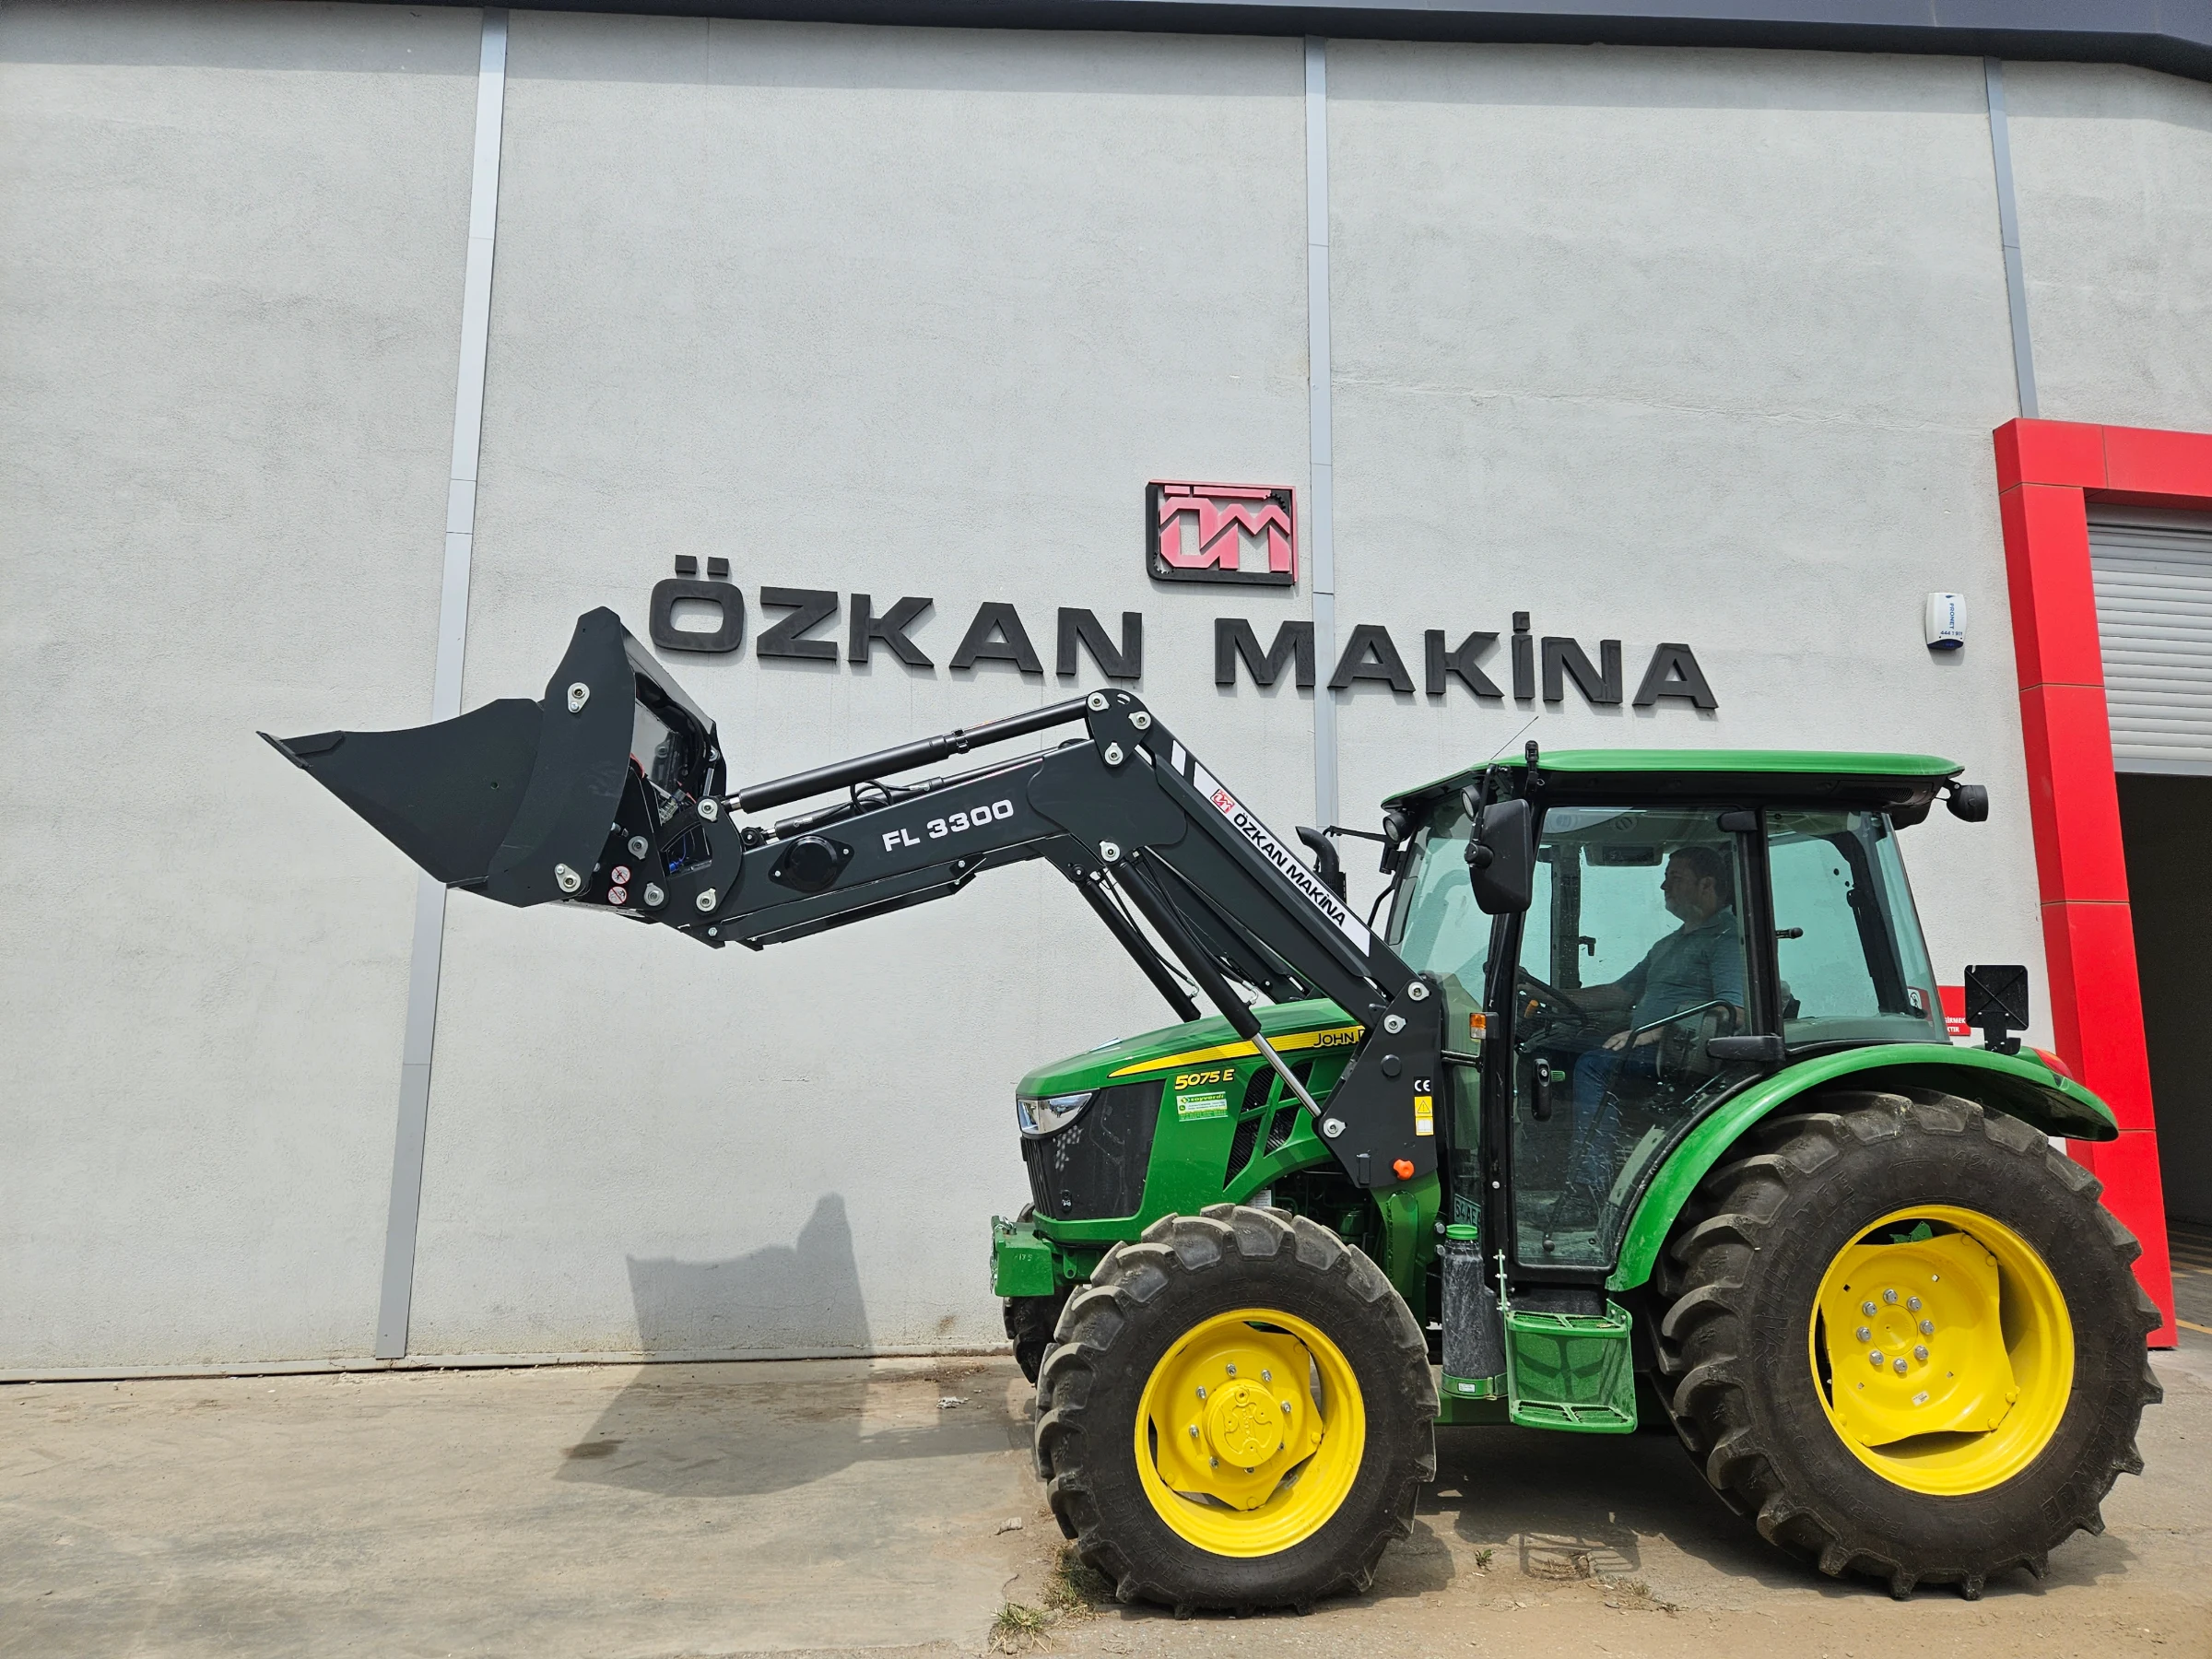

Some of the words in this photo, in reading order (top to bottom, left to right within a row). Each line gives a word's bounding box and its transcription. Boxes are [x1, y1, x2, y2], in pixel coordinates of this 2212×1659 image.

[648, 554, 1142, 680] ÖZKAN
[1214, 611, 1719, 710] MAKİNA
[881, 828, 920, 853] FL
[926, 799, 1014, 839] 3300
[1233, 812, 1288, 867] ÖZKAN
[1286, 864, 1346, 927] MAKİNA
[1313, 1031, 1355, 1047] JOHN
[1174, 1070, 1221, 1090] 5075
[1222, 1068, 1235, 1082] E
[1414, 1079, 1430, 1092] CE
